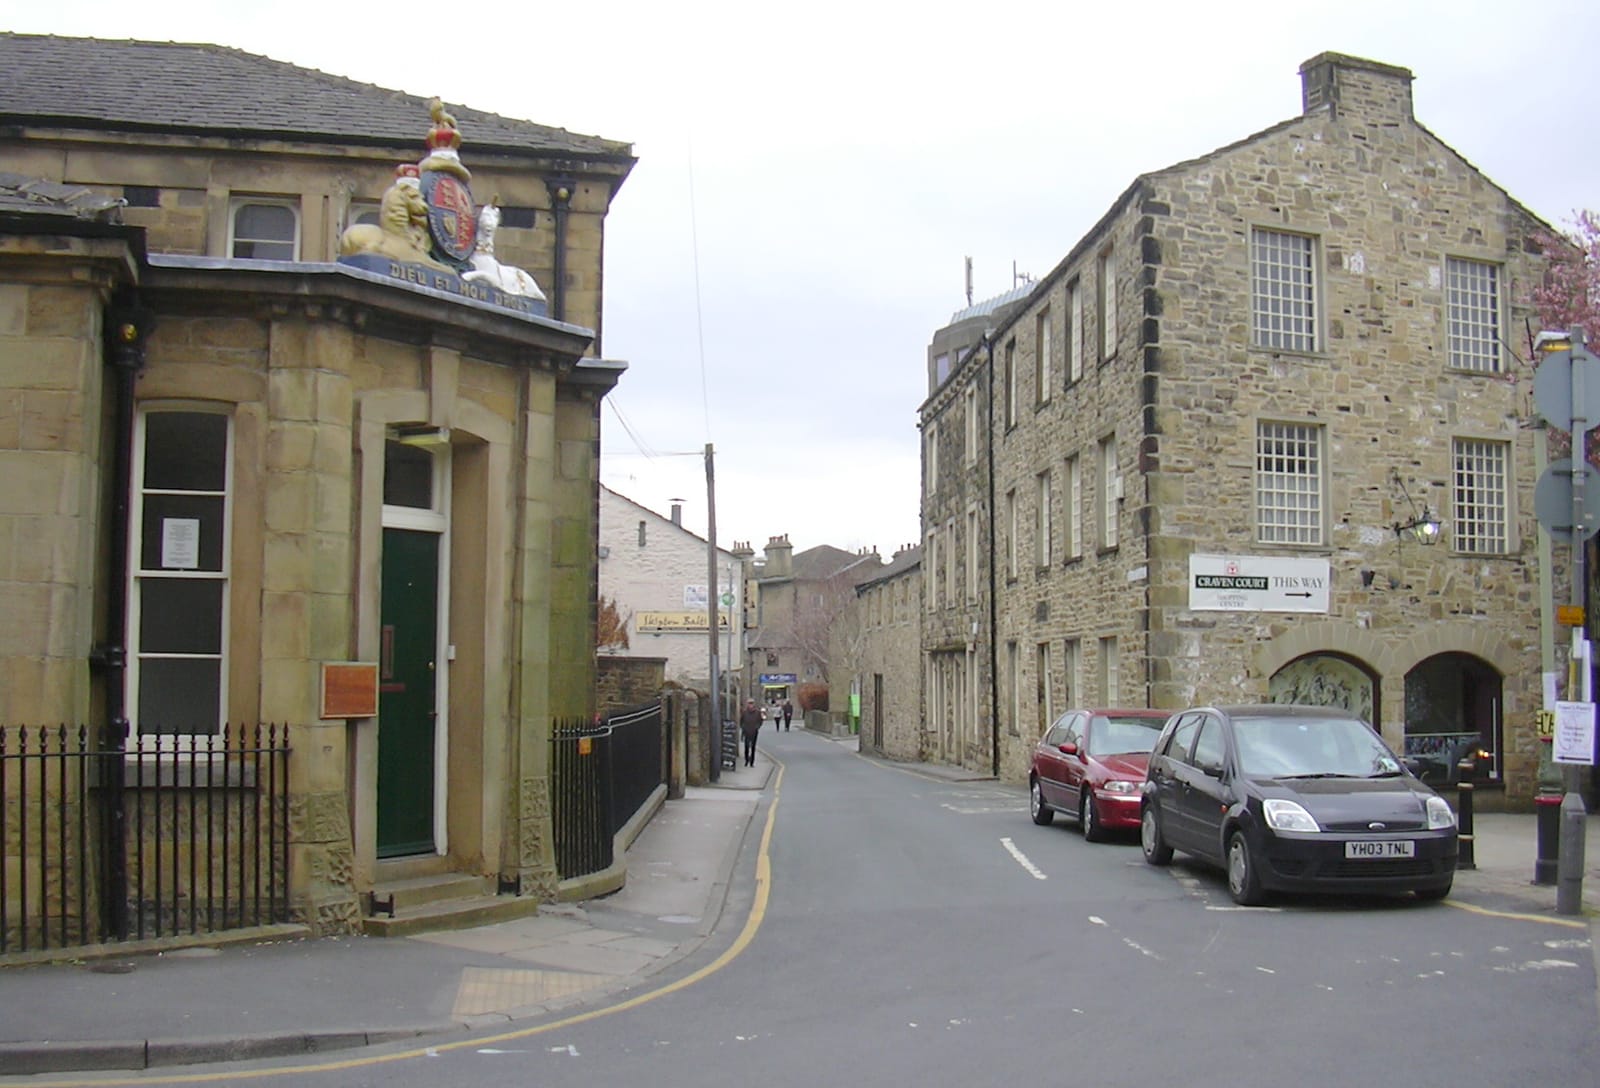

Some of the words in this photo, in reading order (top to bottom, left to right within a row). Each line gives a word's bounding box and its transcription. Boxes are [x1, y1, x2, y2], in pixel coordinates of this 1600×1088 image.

[390, 263, 427, 284] DIEU
[435, 276, 450, 289] ET
[459, 282, 488, 299] MON
[1197, 576, 1235, 588] CRAVEN
[1235, 577, 1267, 589] COURT
[1273, 576, 1298, 588] THIS
[1301, 577, 1324, 589] WAY
[1351, 843, 1383, 855] YH03
[1387, 842, 1409, 854] TNL
